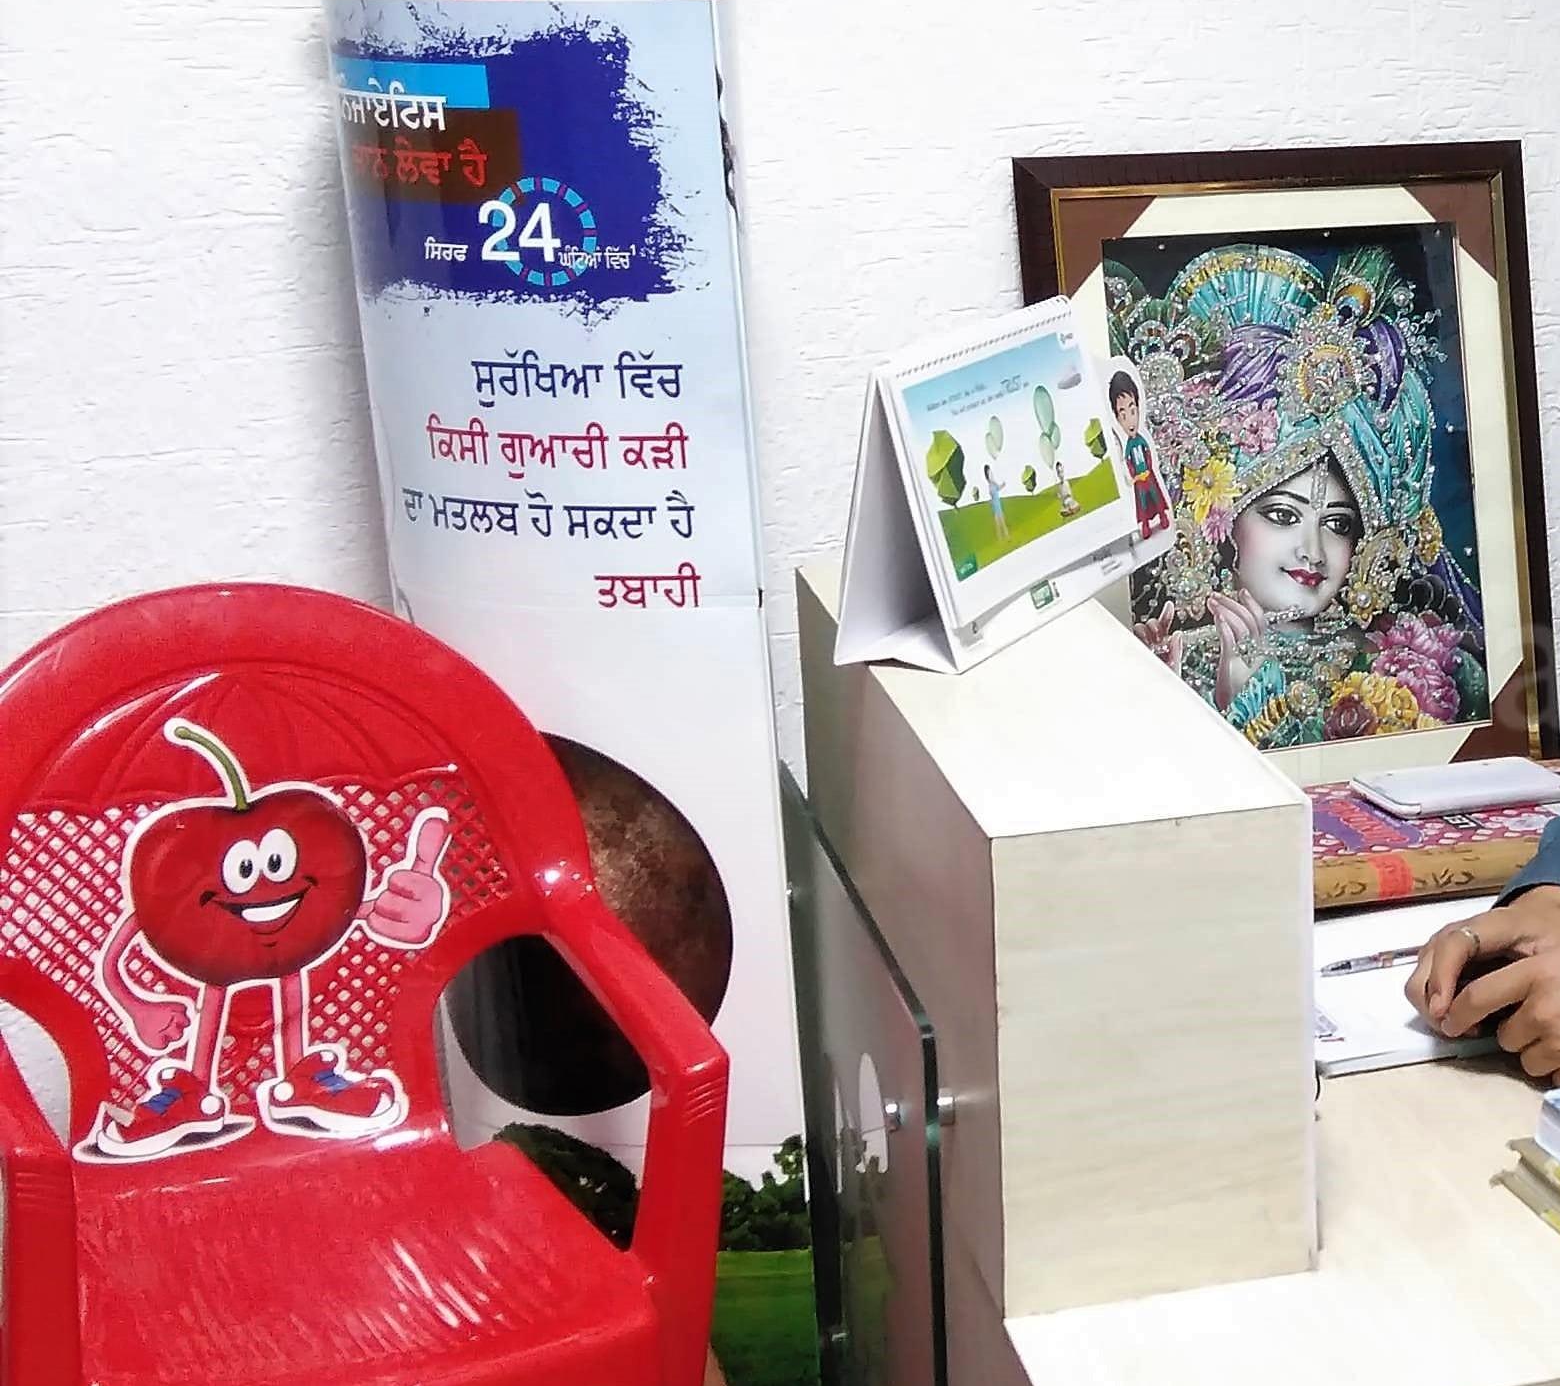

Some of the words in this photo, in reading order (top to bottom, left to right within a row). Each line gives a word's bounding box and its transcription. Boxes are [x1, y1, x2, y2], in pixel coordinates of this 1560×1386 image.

[457, 137, 488, 188] ਹੈ
[478, 199, 562, 263] 24
[471, 349, 604, 408] ਸੁਰੱਖਿਆ
[613, 349, 684, 399] ਵਿੱਚ
[426, 413, 489, 465] ਕਿਸੀ
[498, 421, 609, 479] ਗੁਆਚੀ
[618, 421, 690, 469] ਕੜੀ
[402, 488, 424, 522] ਦਾ
[428, 494, 519, 536] ਮਤਲਬ
[524, 488, 553, 537] ਹੋ
[562, 505, 657, 539] ਸਕਦਾ
[666, 490, 695, 538] ਹੈ
[593, 561, 702, 608] ਤਬਾਹੀ
